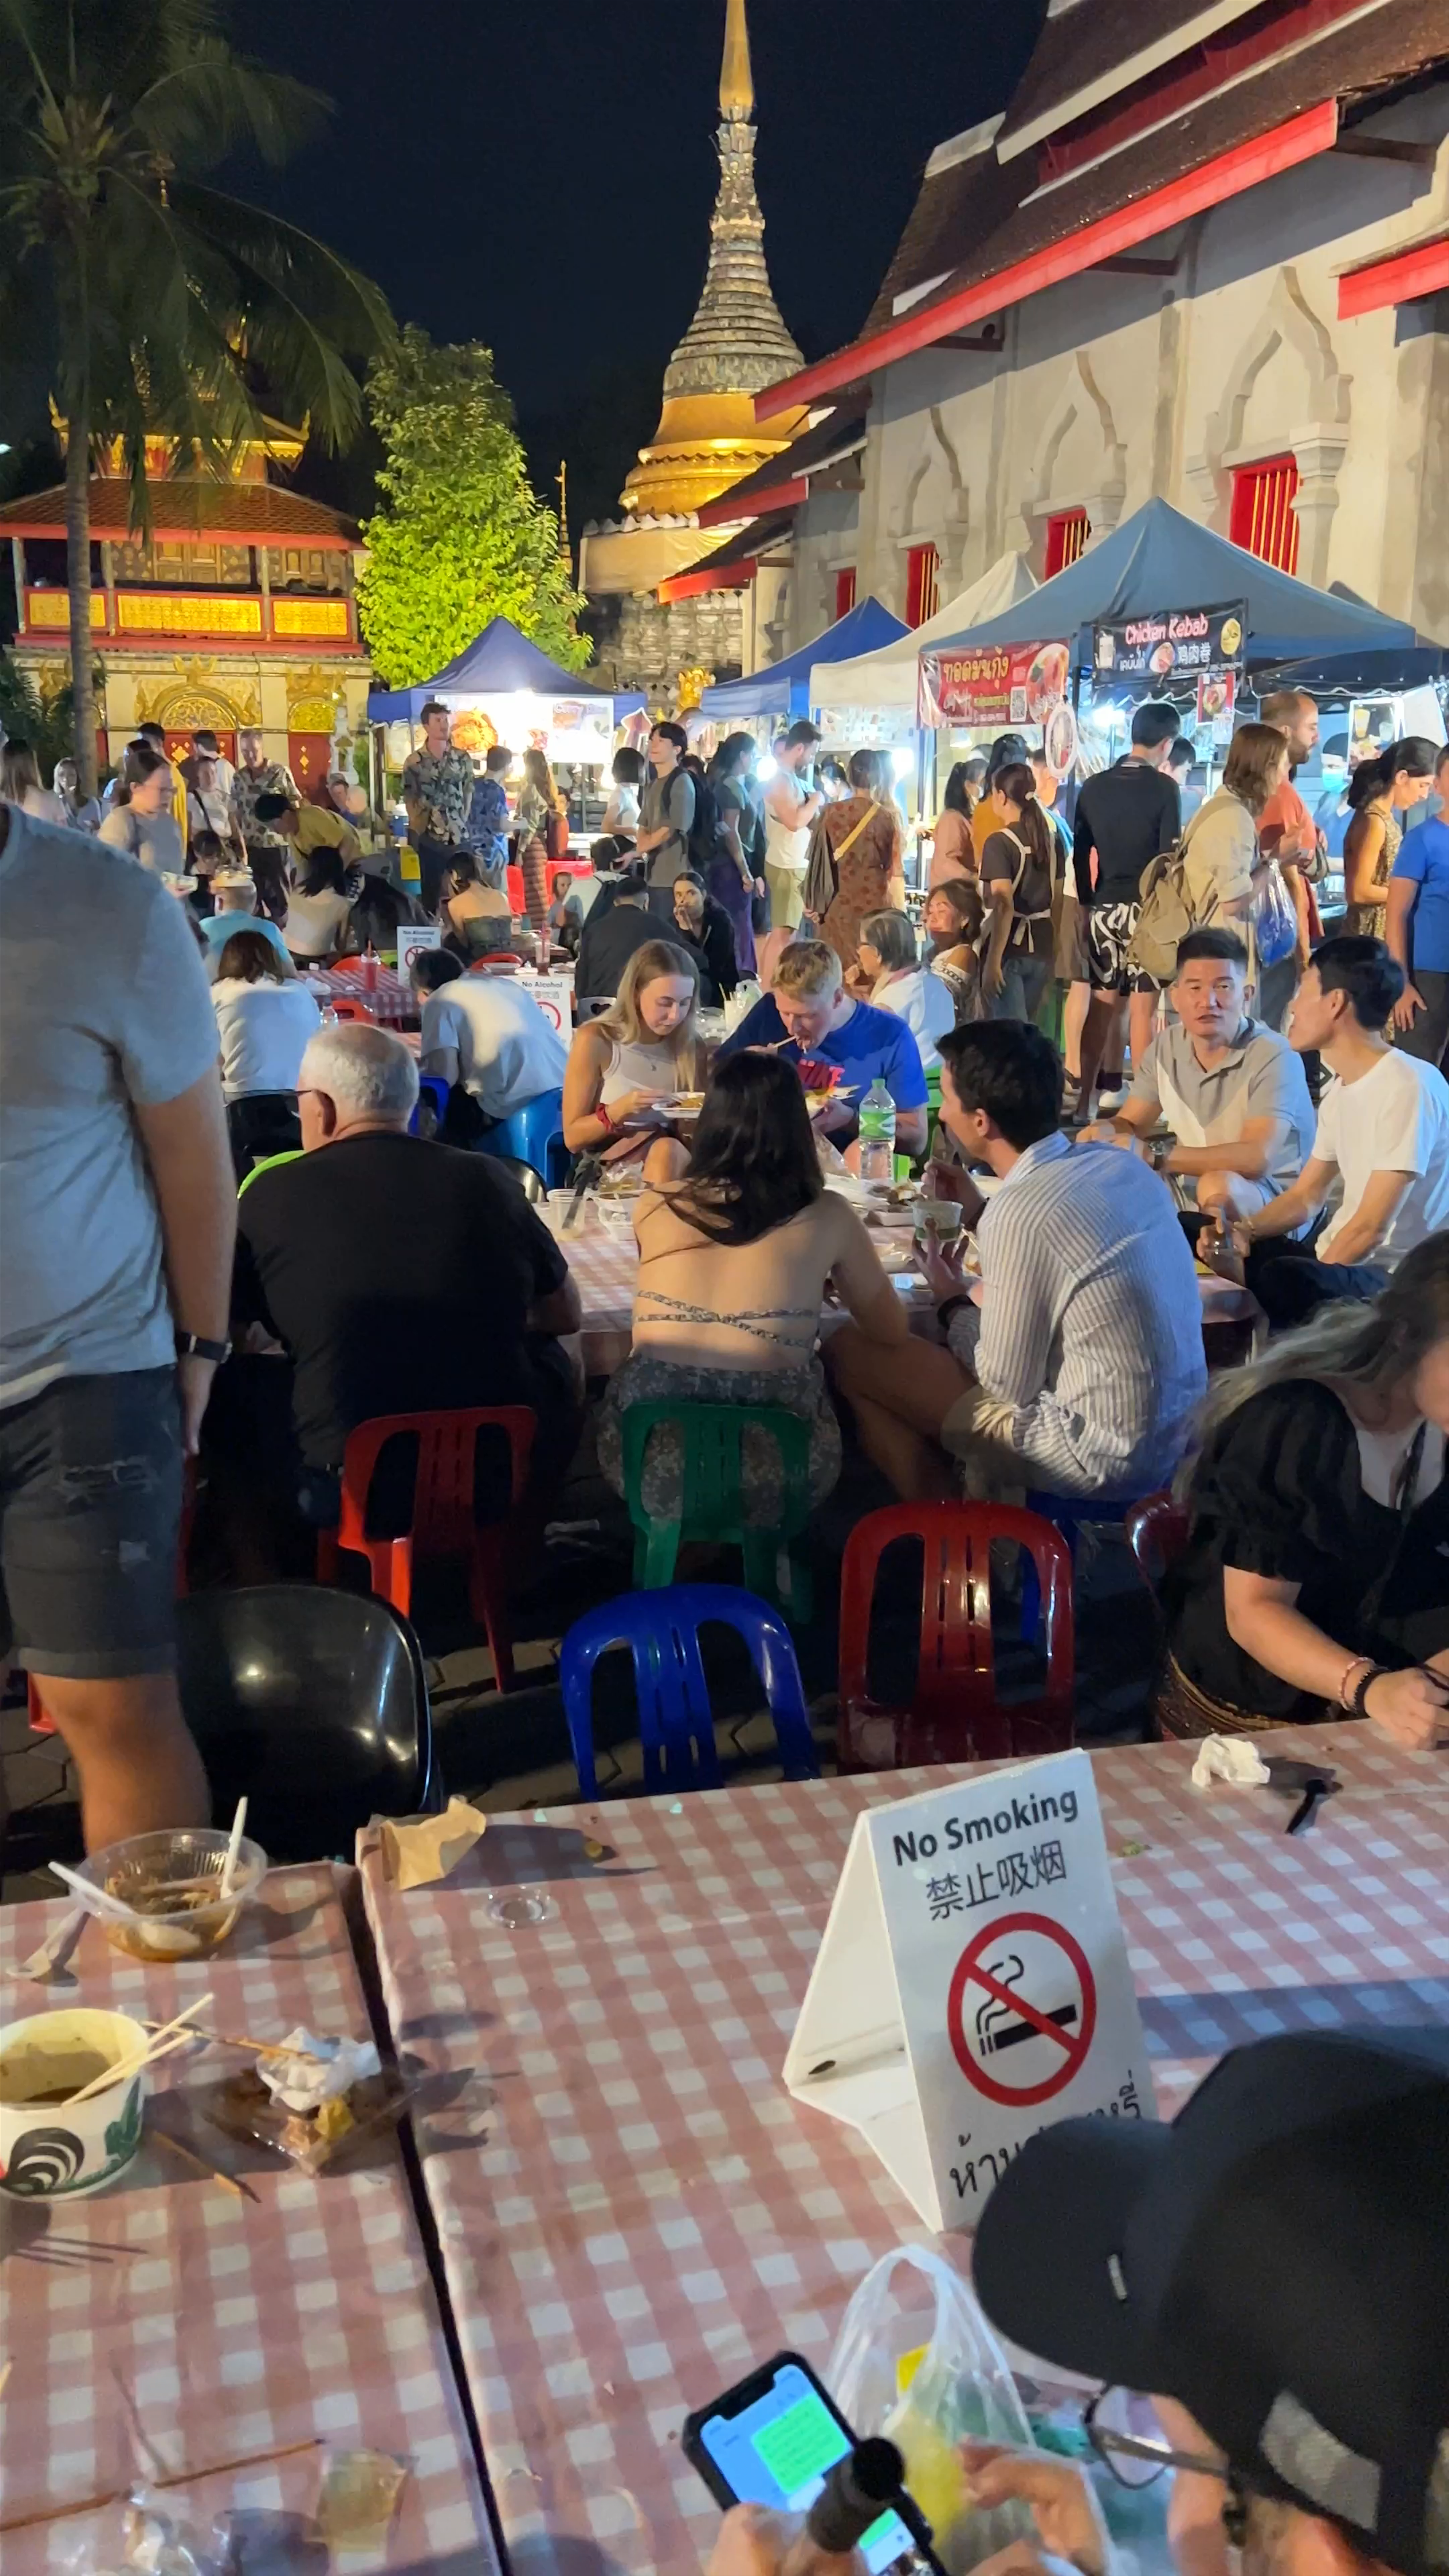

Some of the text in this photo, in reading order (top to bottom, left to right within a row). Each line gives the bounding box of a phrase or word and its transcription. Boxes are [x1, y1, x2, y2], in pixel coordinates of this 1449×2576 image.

[1125, 621, 1166, 645] Chicken
[1169, 612, 1209, 639] Kebab
[943, 646, 1009, 690] ทอดมันกุ้ง
[893, 1790, 1078, 1866] No Smoking
[926, 1840, 1067, 1920] 禁止吸烟
